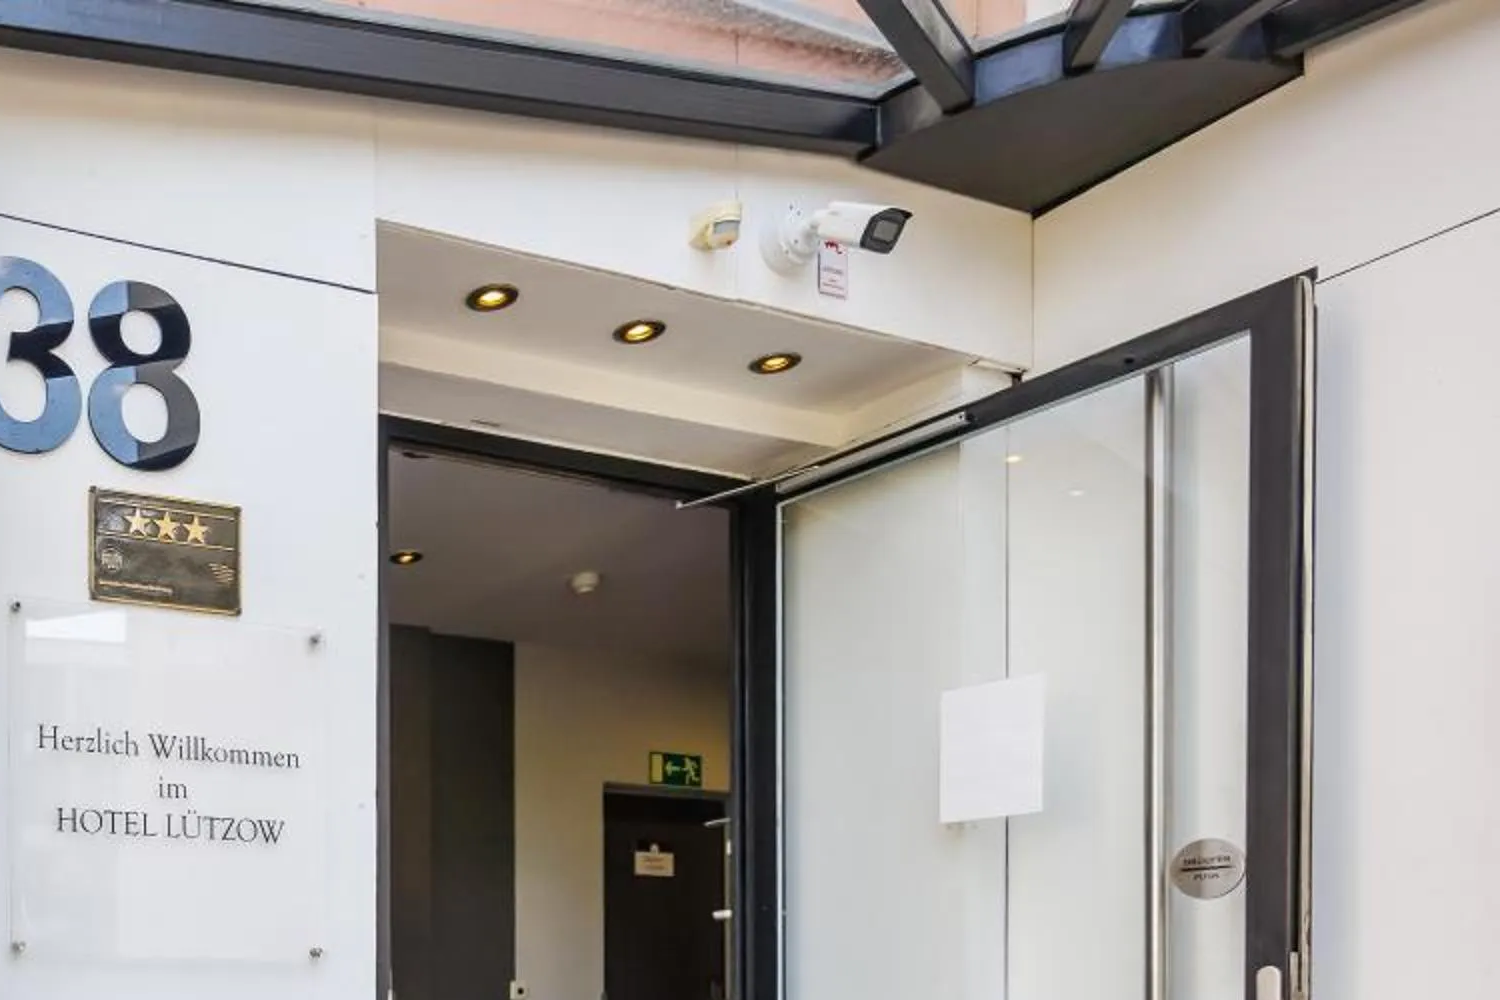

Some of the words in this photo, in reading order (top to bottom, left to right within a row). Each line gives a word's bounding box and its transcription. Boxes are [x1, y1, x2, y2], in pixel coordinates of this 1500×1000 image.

[38, 723, 140, 757] Herzlich
[147, 732, 301, 769] Willkommen
[158, 776, 188, 799] im
[56, 807, 157, 837] HOTEL
[166, 810, 285, 844] LÜTZOW
